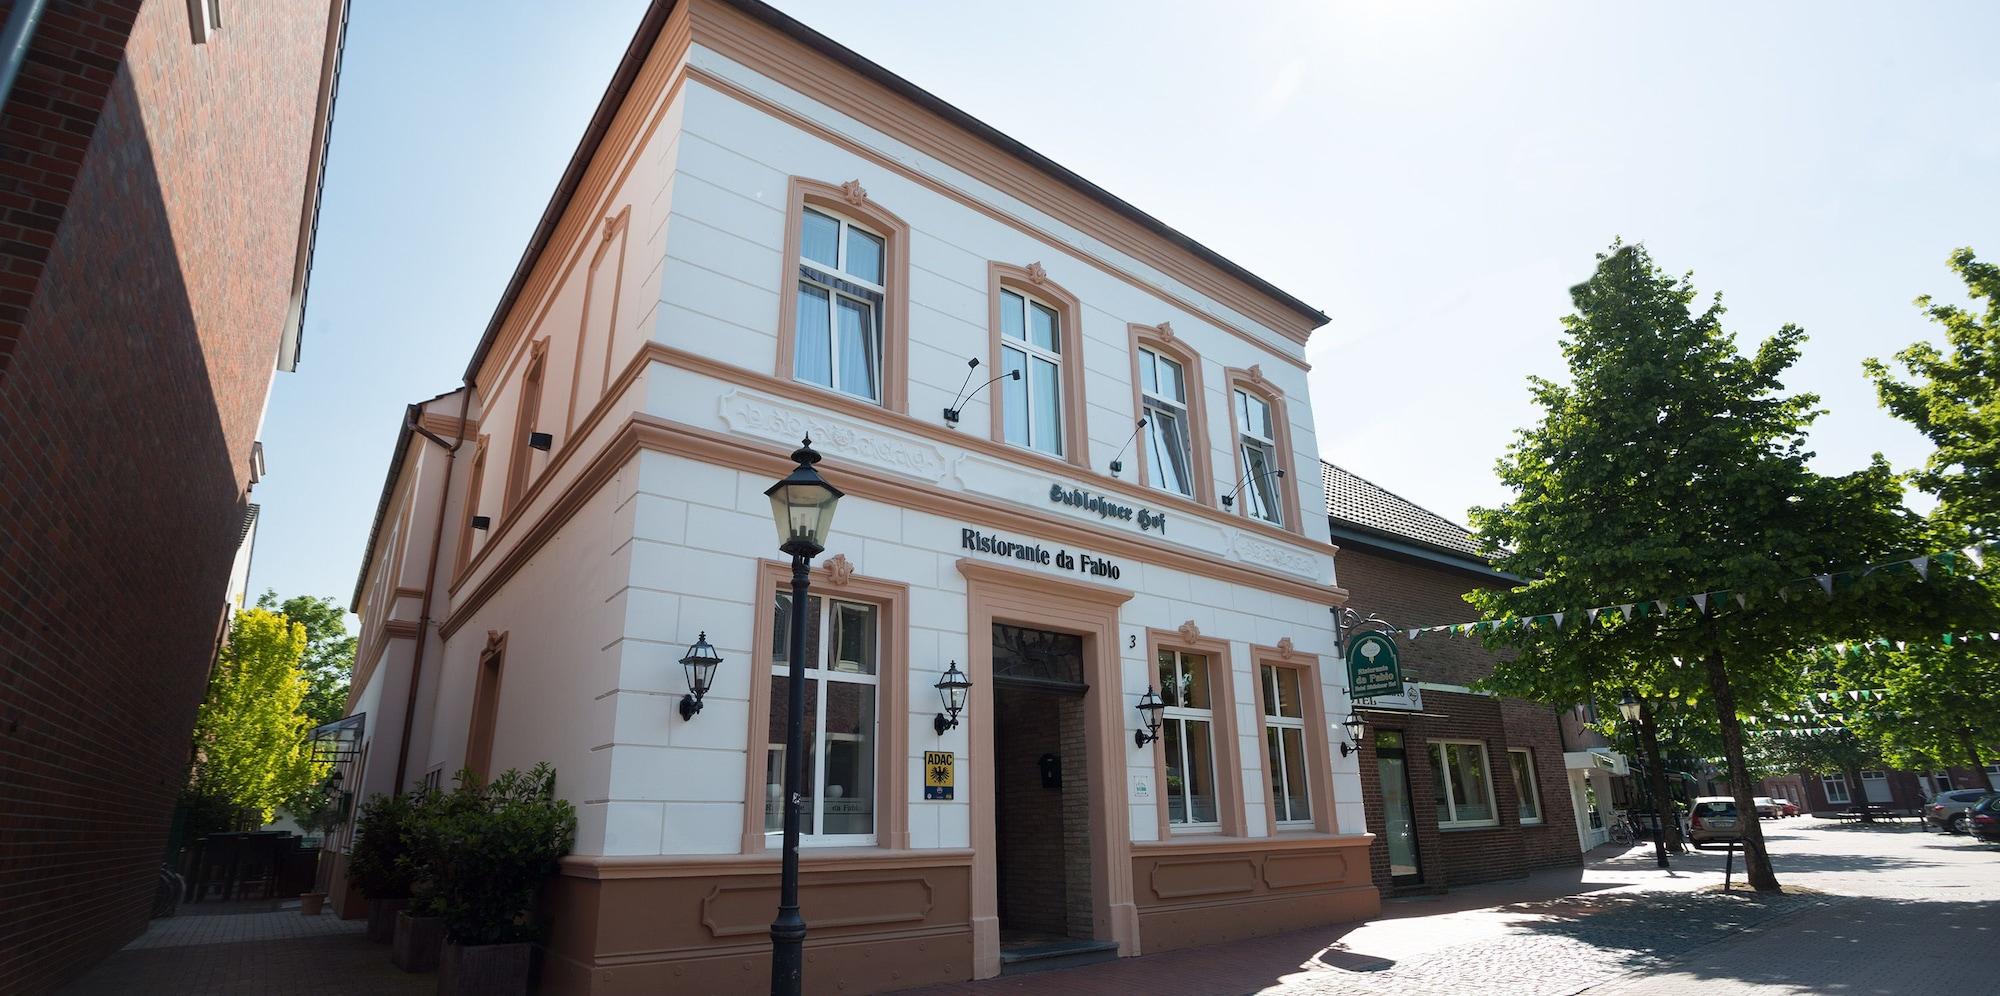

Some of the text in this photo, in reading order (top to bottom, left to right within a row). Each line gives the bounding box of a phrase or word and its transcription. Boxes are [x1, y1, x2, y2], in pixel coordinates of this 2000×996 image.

[962, 528, 1120, 580] Ristorante da Fabio
[1129, 634, 1136, 649] 3
[928, 753, 952, 766] ADAC
